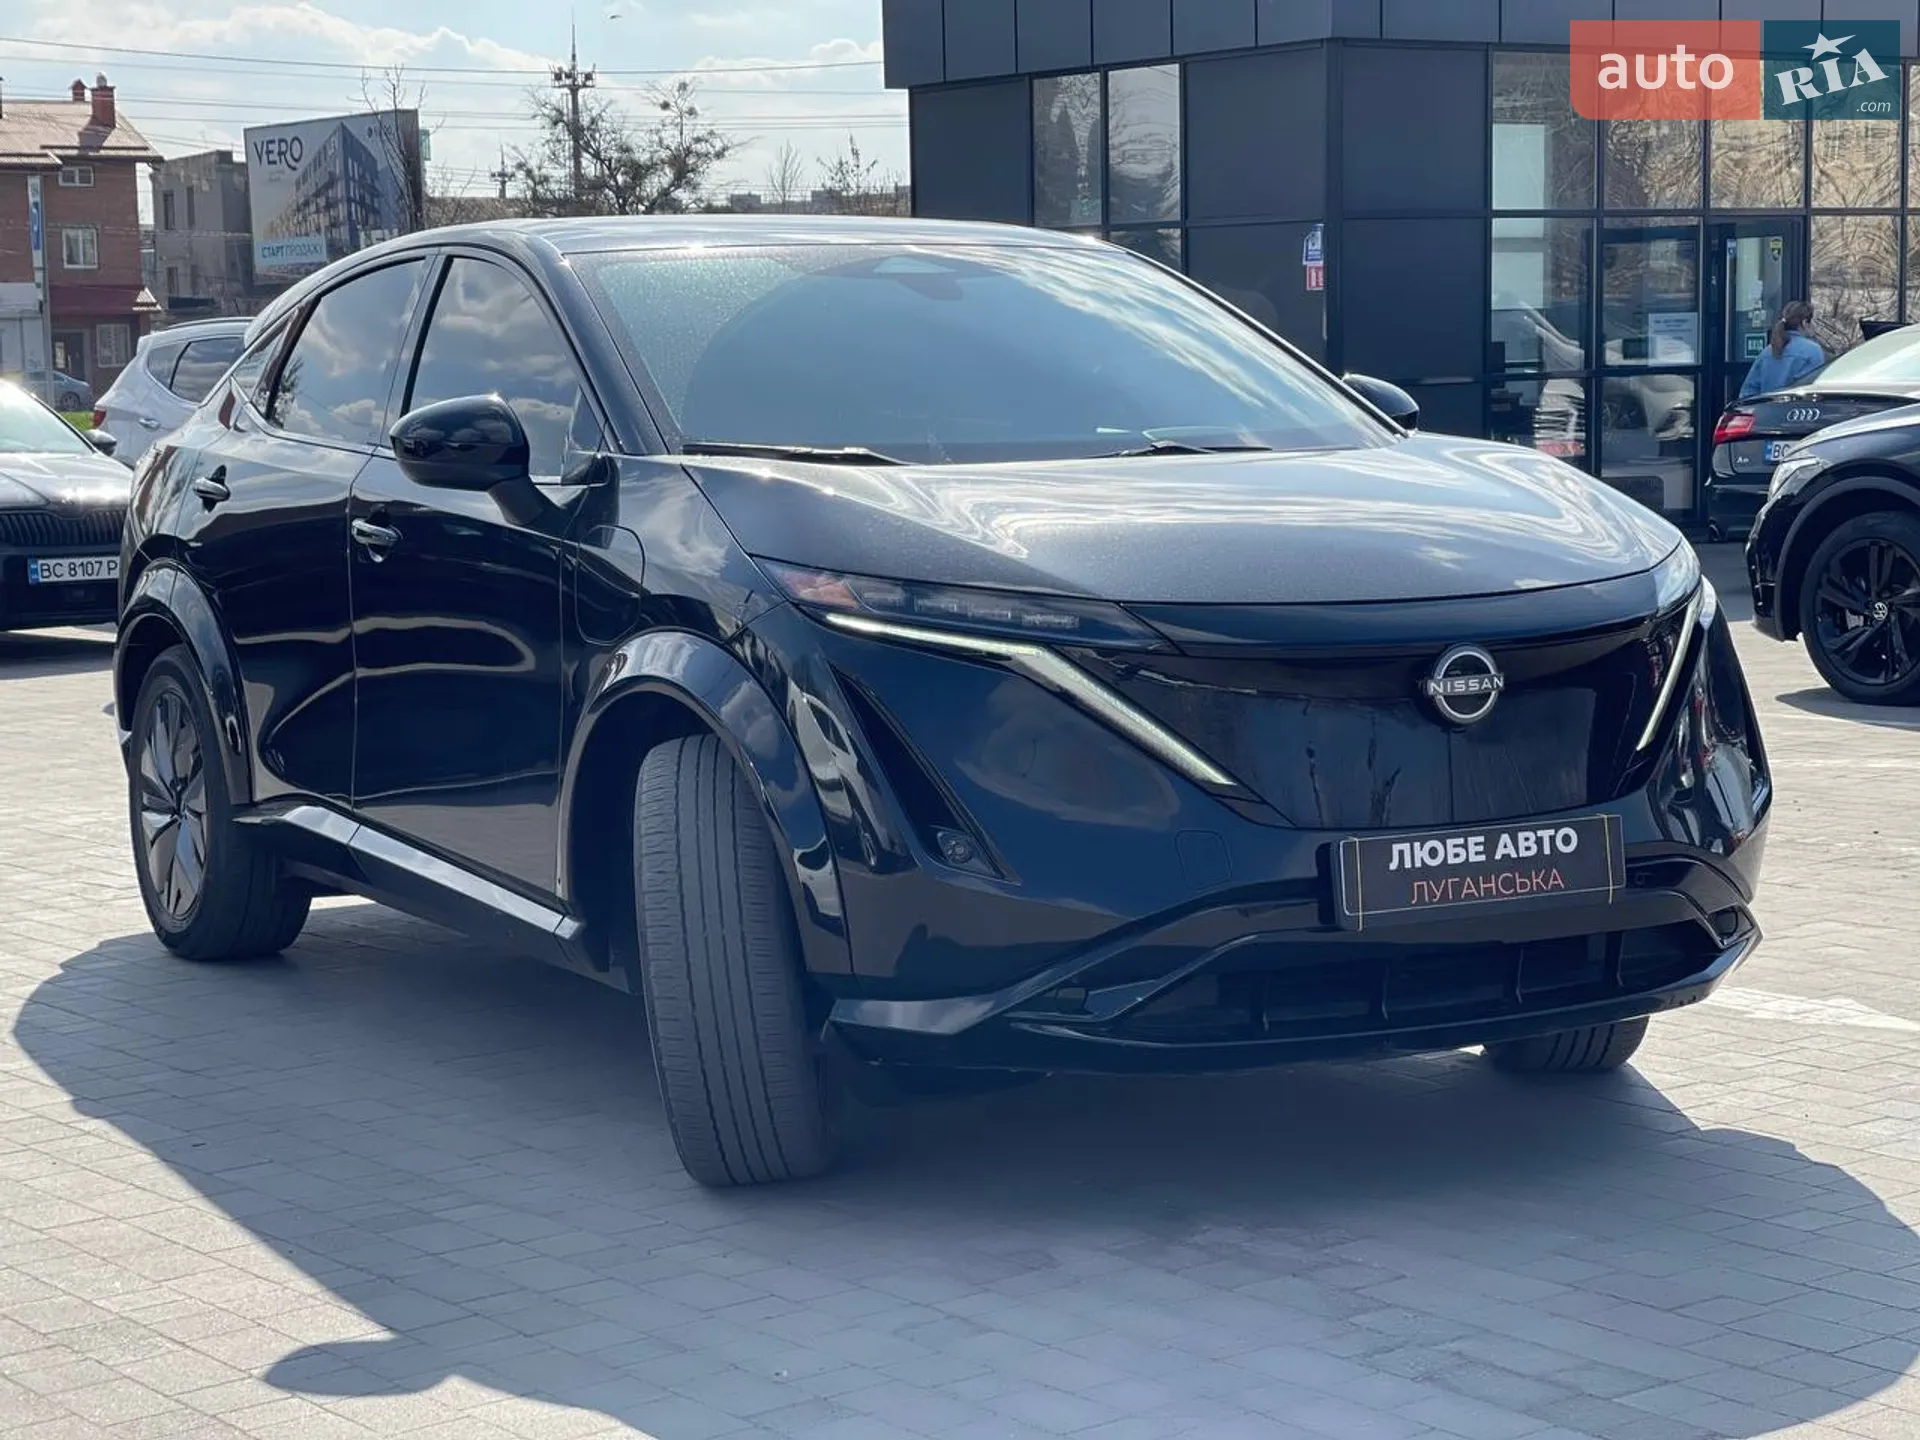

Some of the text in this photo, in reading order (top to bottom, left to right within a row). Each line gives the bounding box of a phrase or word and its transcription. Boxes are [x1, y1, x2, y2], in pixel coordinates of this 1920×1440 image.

[254, 136, 303, 170] VERO
[40, 562, 63, 579] BC
[67, 560, 103, 578] 8107
[1429, 676, 1504, 693] NISSAN
[1389, 827, 1578, 871] ЛЮБЕ АВТО
[1411, 868, 1565, 905] ЛУГАНСЬКА
